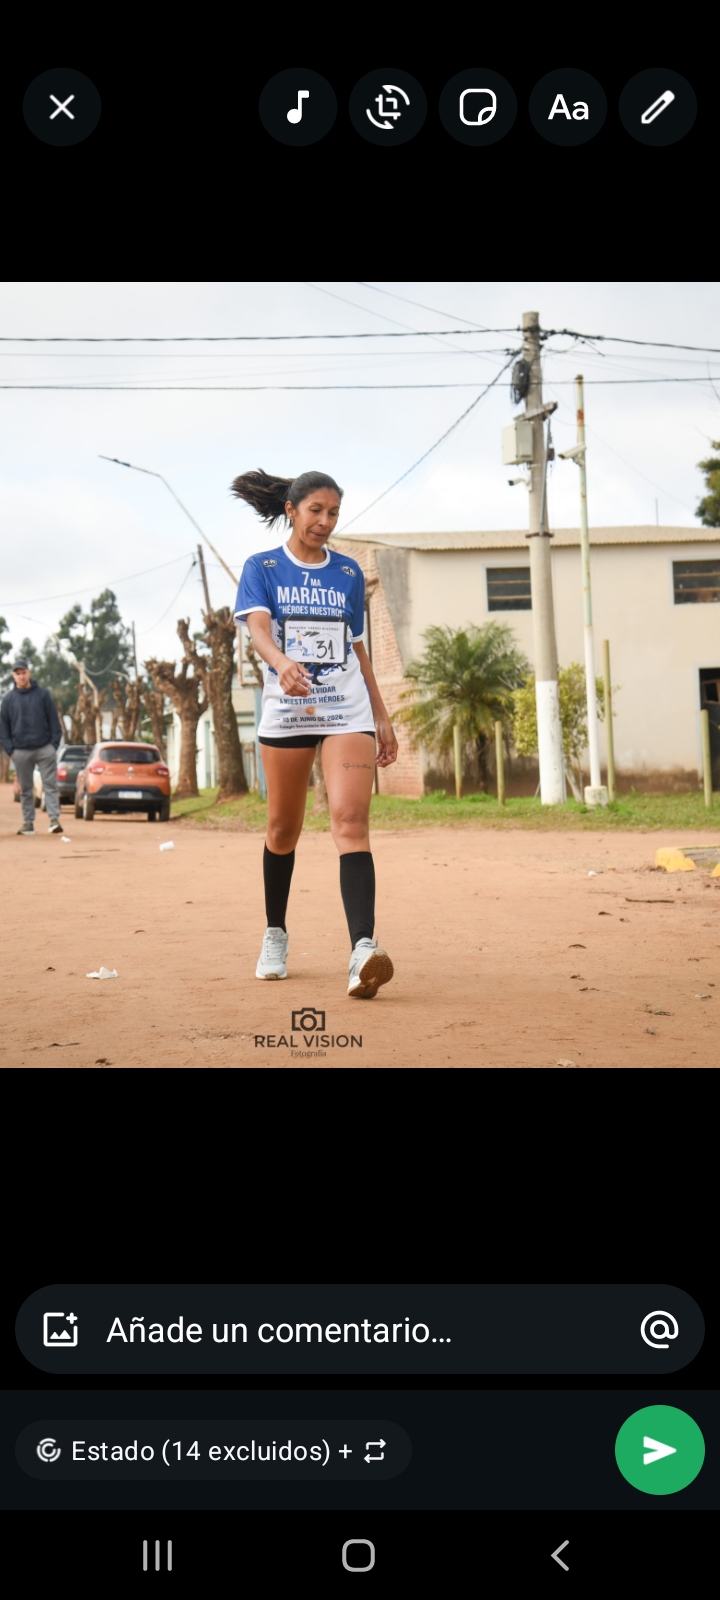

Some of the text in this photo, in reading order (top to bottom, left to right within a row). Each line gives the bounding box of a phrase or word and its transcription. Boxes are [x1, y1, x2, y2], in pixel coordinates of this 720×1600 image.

[548, 94, 589, 121] Aa
[301, 571, 322, 587] 7 MA
[277, 586, 346, 609] MARATÓN
[316, 639, 336, 660] 31
[318, 694, 345, 704] HÉROES
[300, 715, 317, 723] JUNIO
[317, 714, 326, 722] DE
[326, 713, 344, 722] 2026
[106, 1314, 203, 1344] Añade
[212, 1322, 248, 1344] un
[72, 1439, 155, 1462] Estado
[161, 1438, 201, 1467] (14
[208, 1438, 331, 1467] excluidos)
